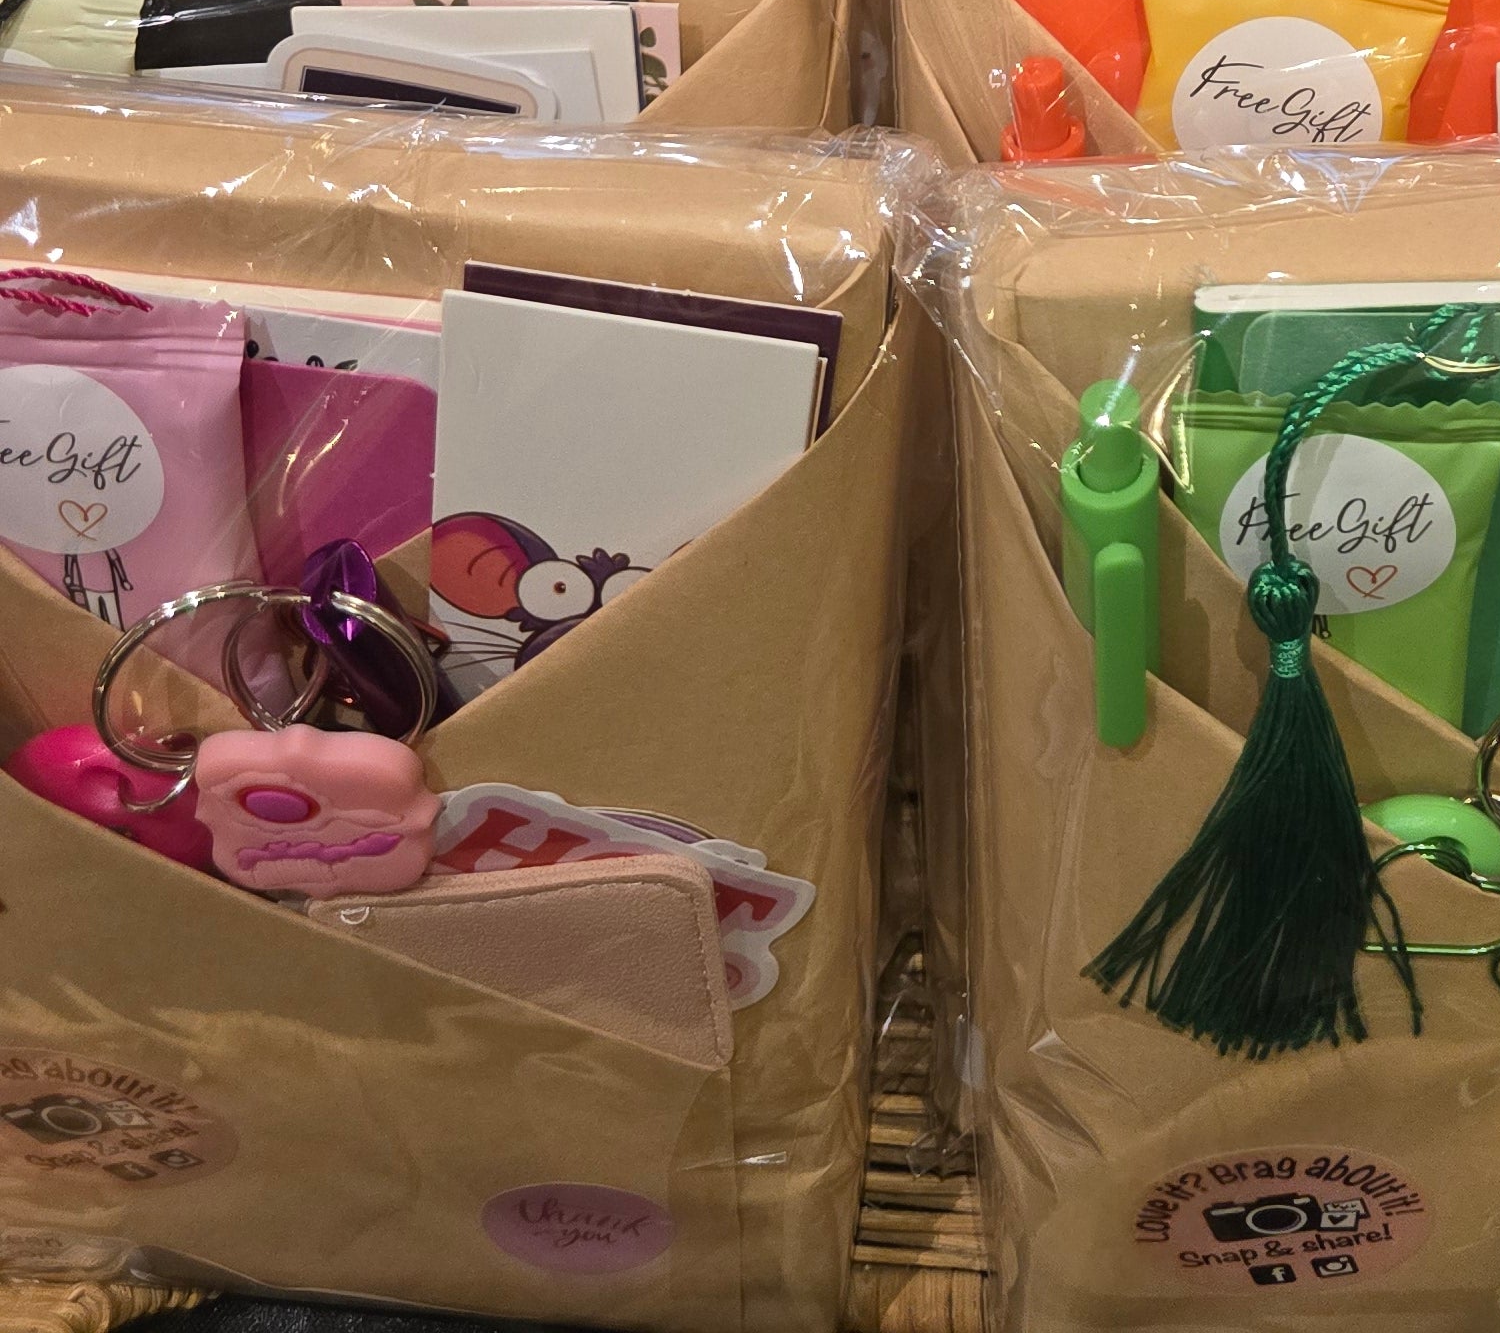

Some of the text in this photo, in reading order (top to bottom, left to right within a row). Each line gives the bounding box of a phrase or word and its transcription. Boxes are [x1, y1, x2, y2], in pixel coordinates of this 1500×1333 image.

[1189, 54, 1372, 143] Free Gift
[46, 431, 142, 491] Gift
[1336, 492, 1434, 554] Gift
[1134, 1154, 1425, 1244] Love it? Brag about it!
[1179, 1223, 1394, 1268] Snap & share!
